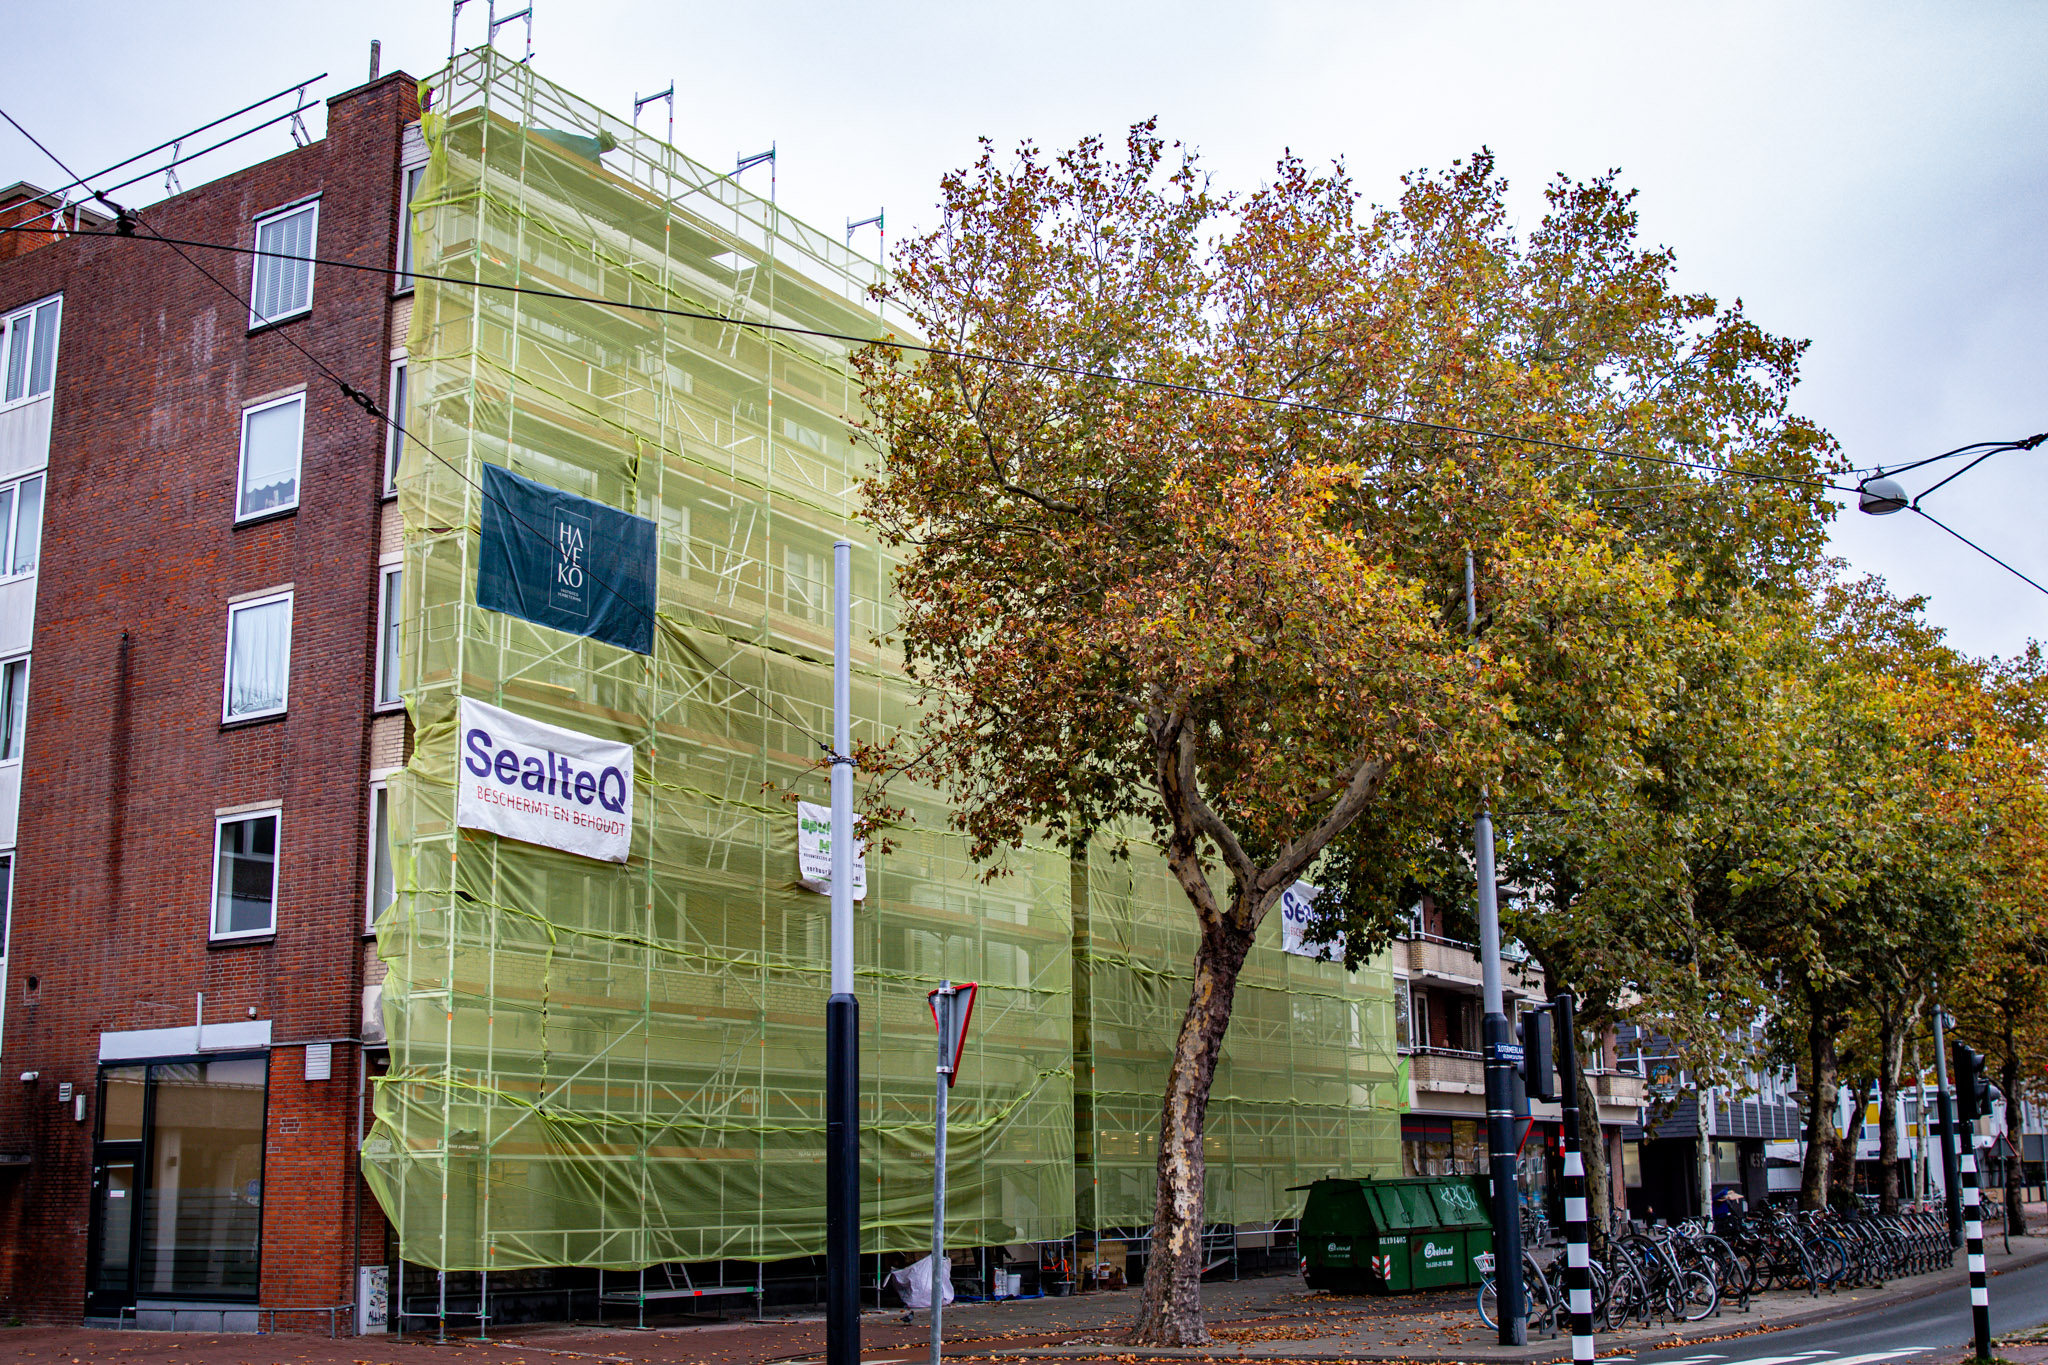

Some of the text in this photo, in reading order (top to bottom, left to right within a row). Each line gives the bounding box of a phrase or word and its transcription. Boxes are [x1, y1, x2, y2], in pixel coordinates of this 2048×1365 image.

[465, 728, 626, 815] SealteQ
[477, 785, 625, 837] BESCHERMT EN BEHOUDT
